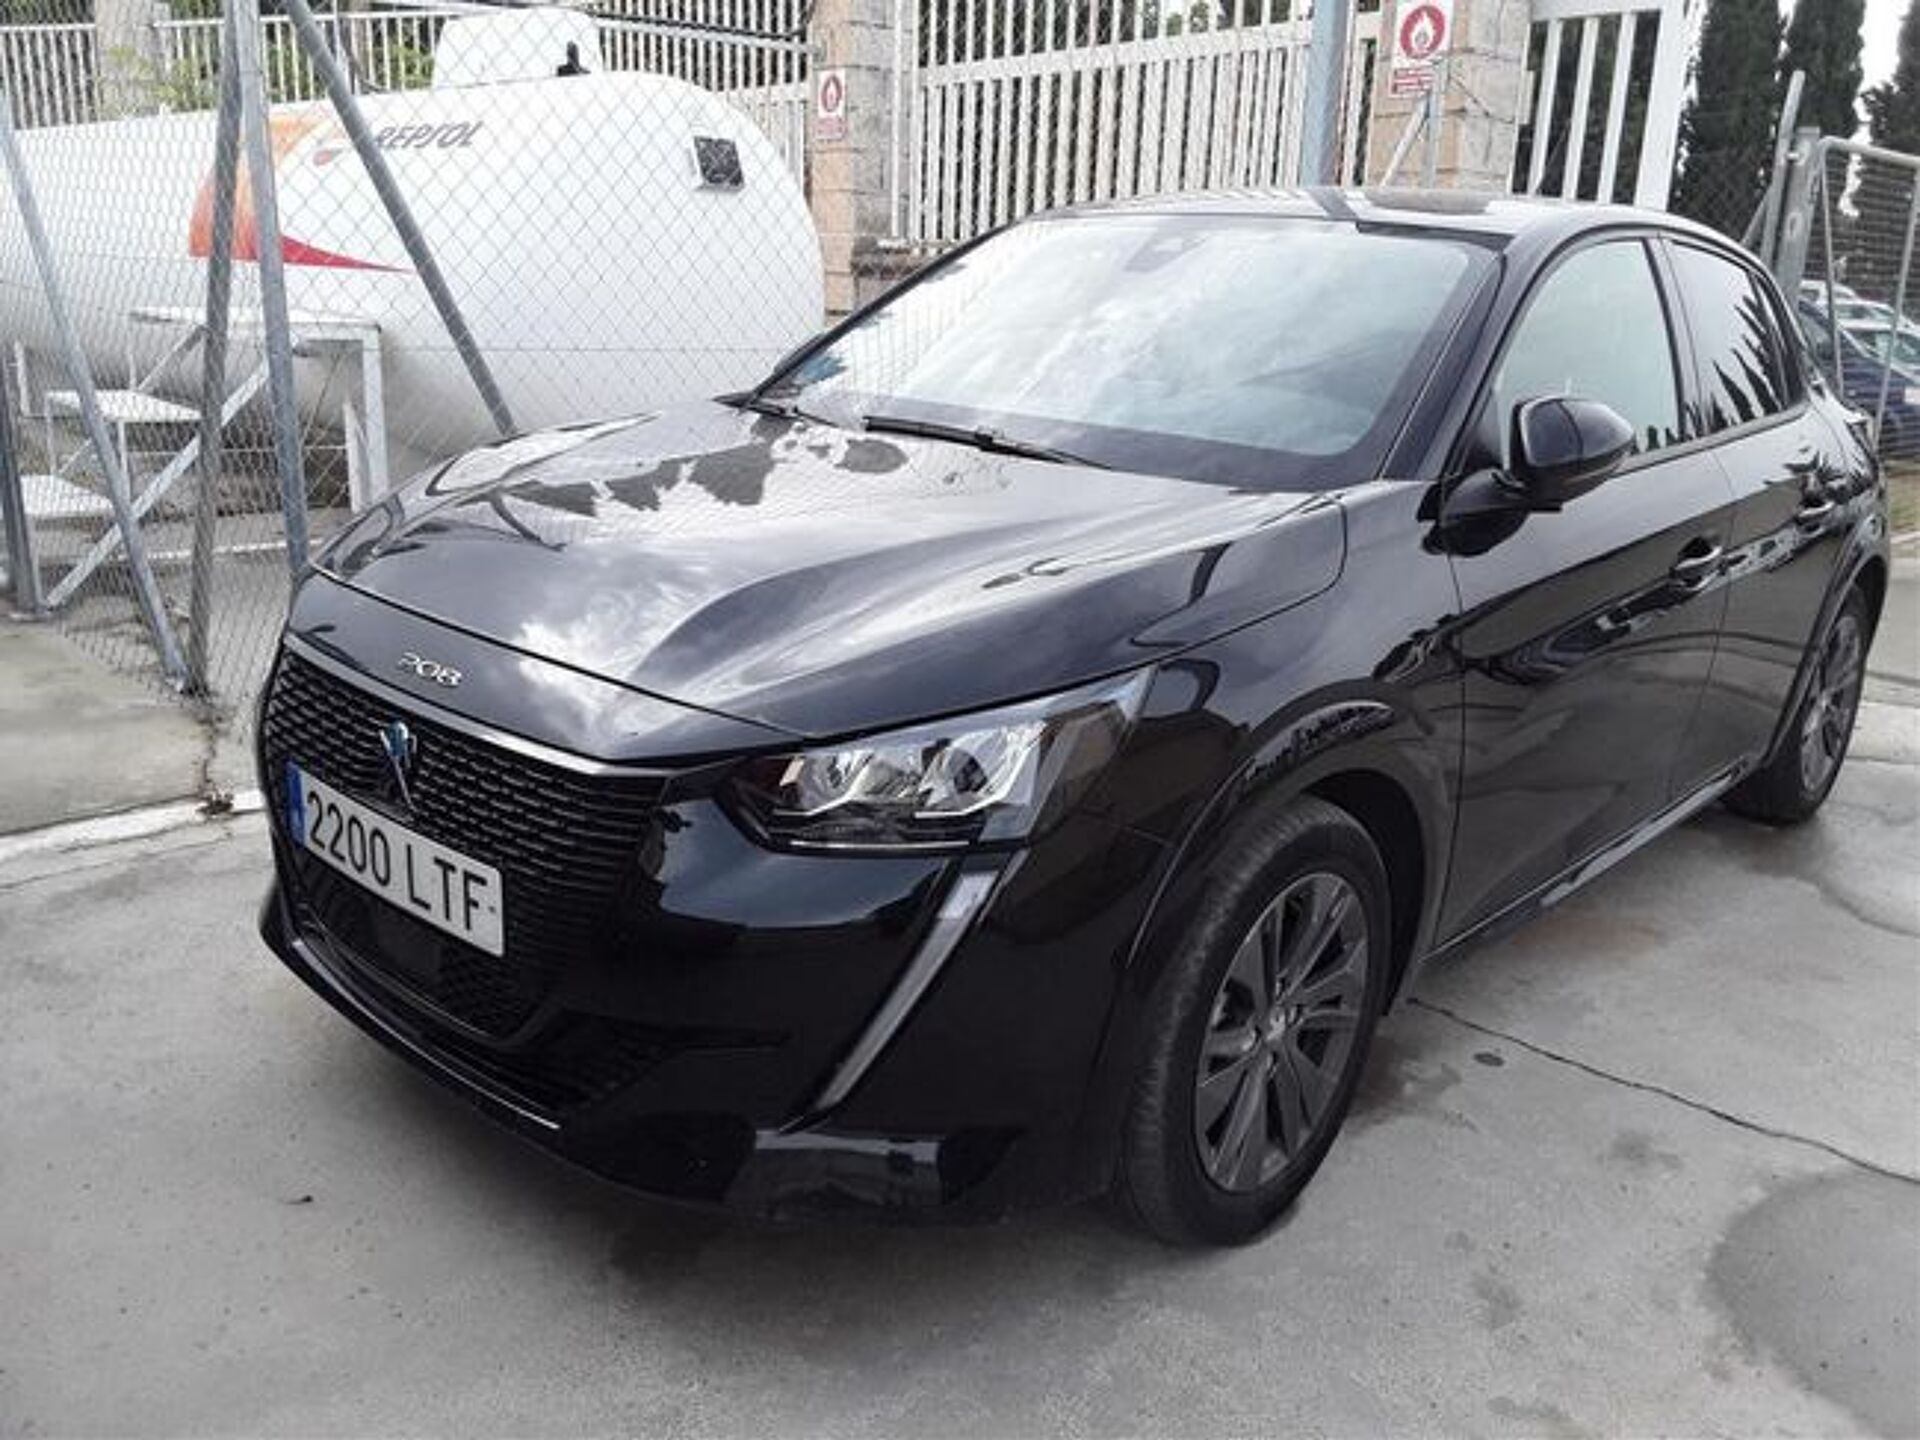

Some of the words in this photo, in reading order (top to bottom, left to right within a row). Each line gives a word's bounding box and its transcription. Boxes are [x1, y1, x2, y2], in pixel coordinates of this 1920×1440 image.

[376, 120, 484, 149] REPSOL
[398, 652, 461, 686] 208
[307, 791, 391, 887] 2200
[406, 843, 488, 931] LTF
